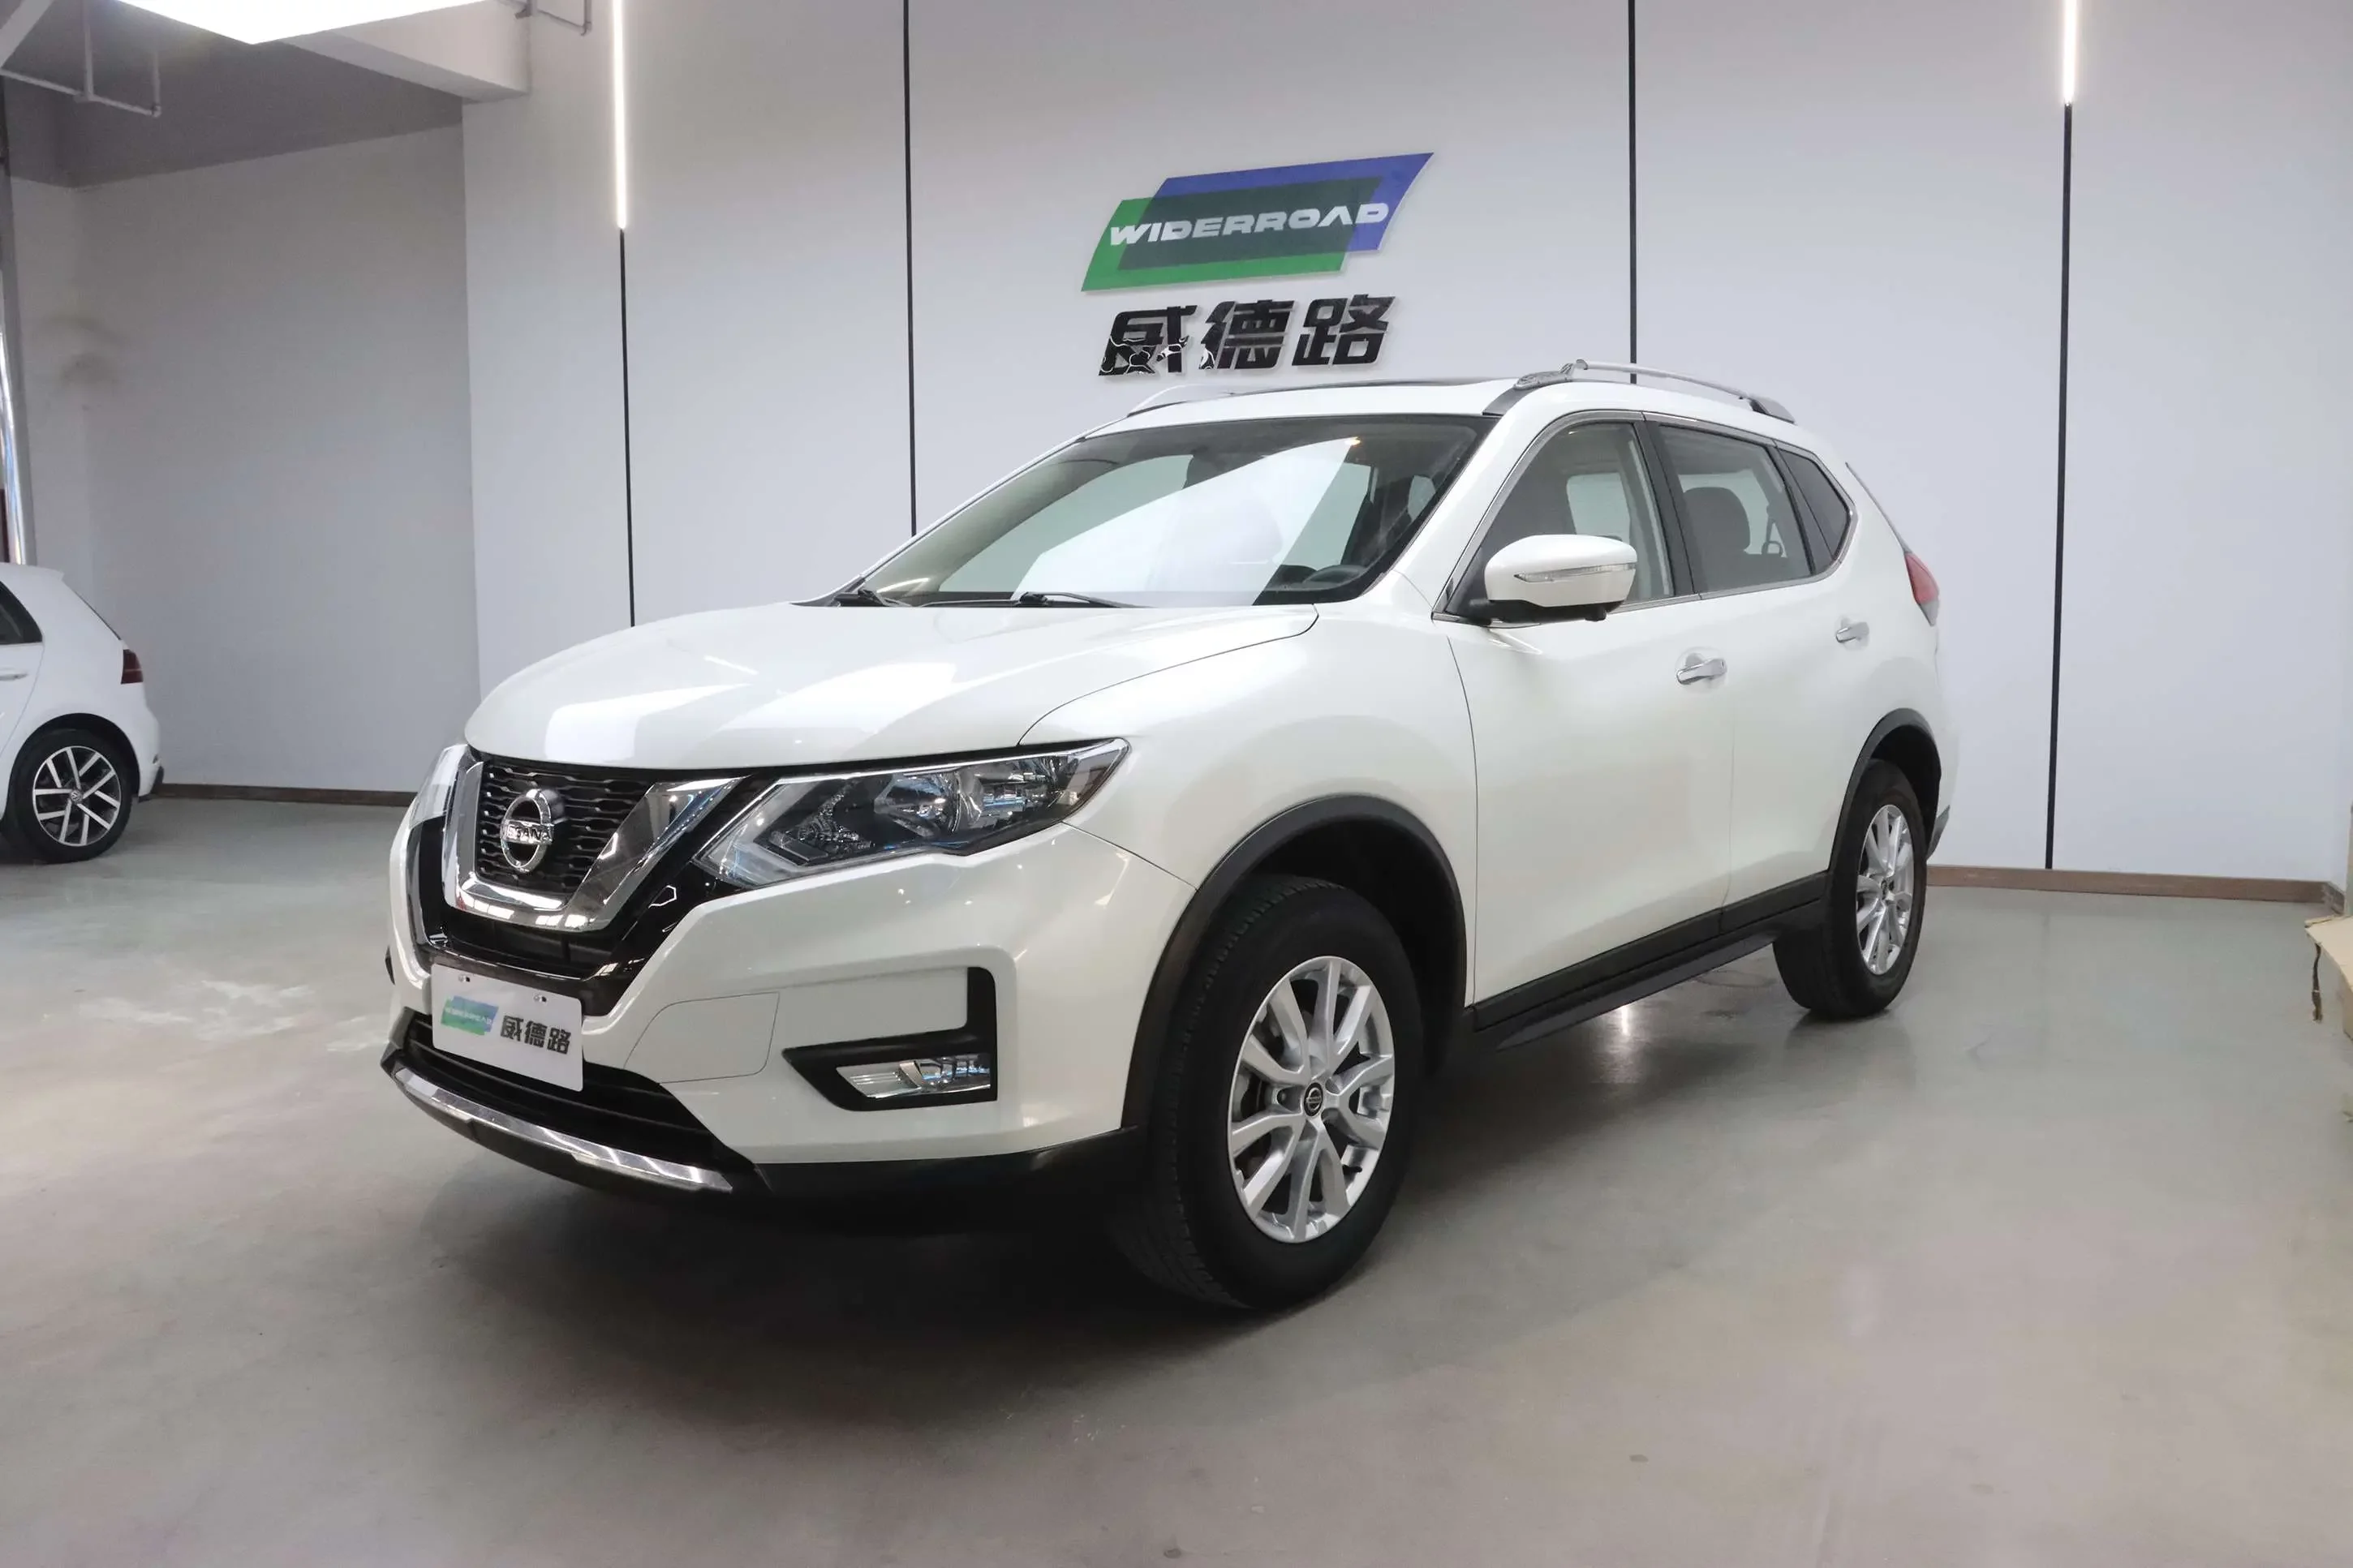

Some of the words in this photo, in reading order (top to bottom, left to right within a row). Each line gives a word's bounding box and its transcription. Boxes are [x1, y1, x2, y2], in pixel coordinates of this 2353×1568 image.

[1110, 203, 1389, 246] WIDERROAD
[1098, 294, 1396, 376] 威德路
[500, 1015, 571, 1055] 威德路
